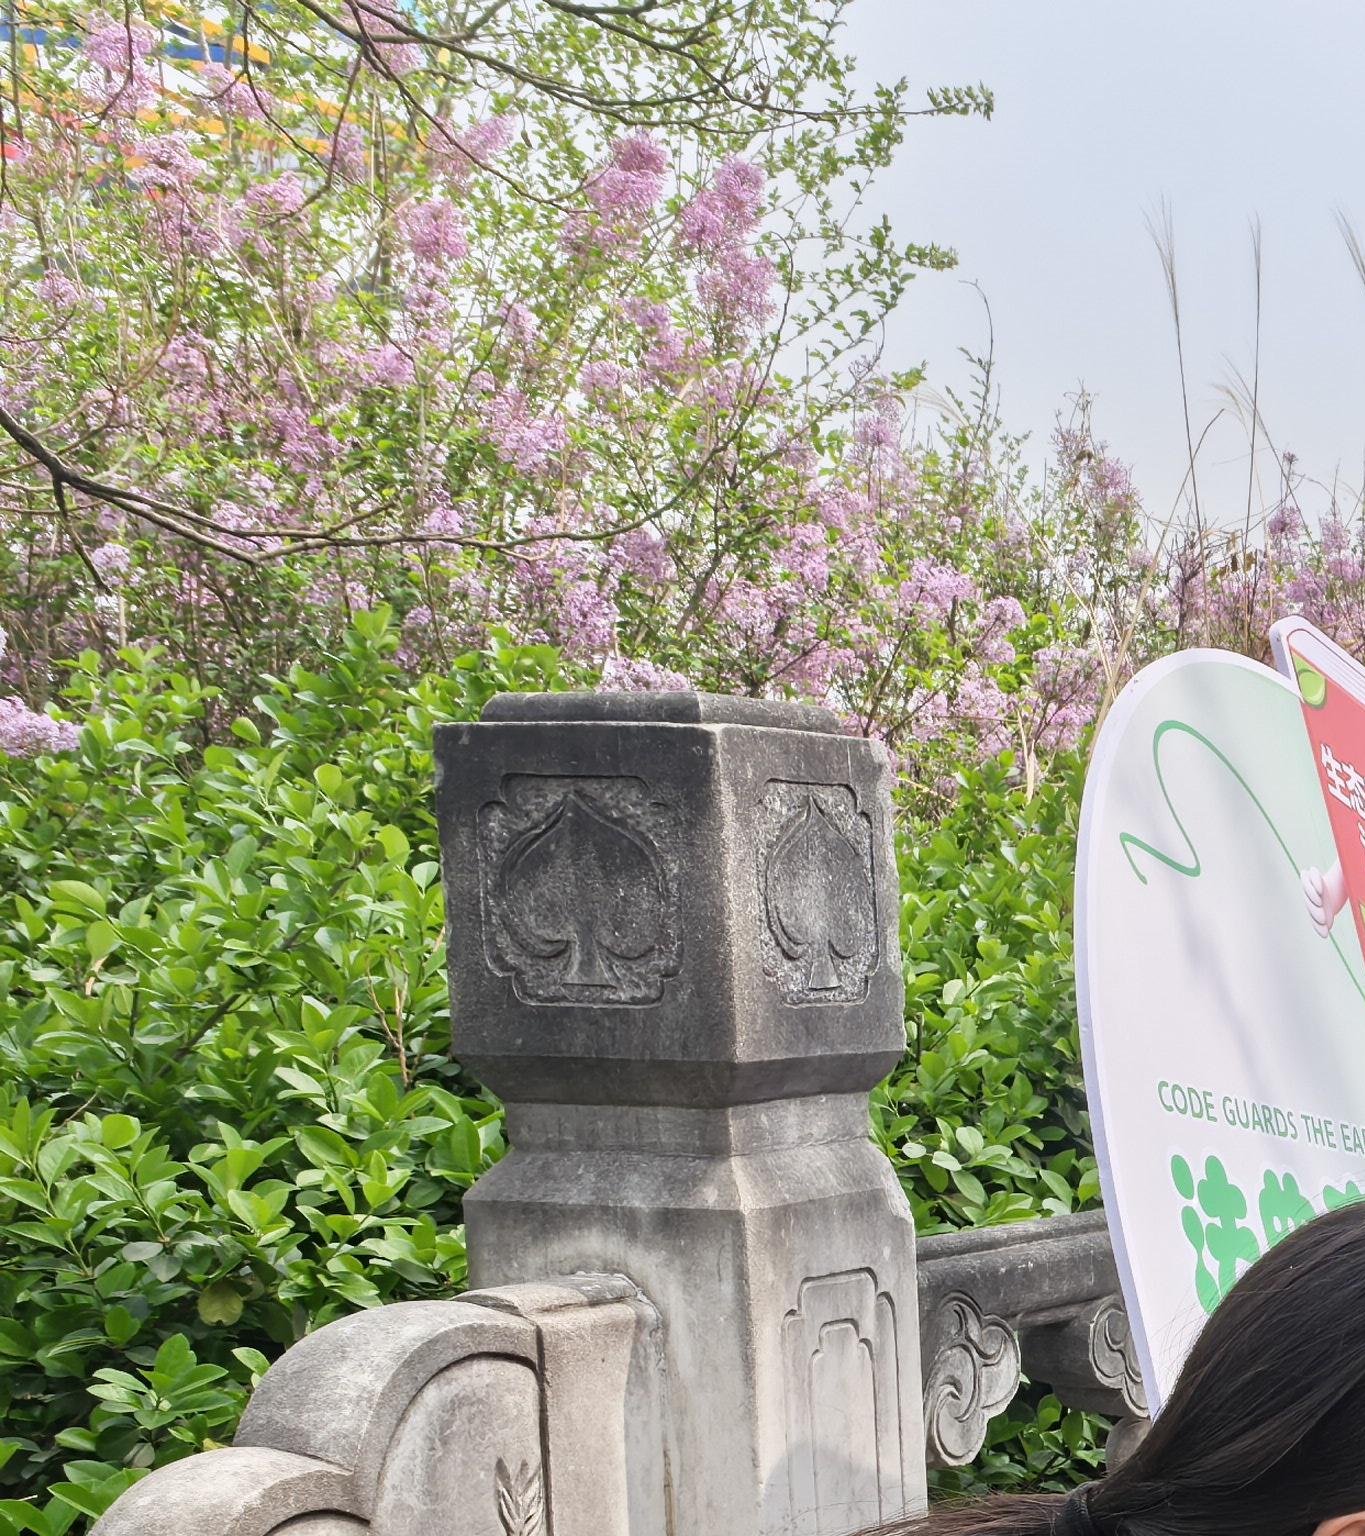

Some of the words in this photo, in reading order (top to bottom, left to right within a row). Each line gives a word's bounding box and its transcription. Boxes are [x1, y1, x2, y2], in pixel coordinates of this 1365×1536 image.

[1157, 1080, 1217, 1123] CODE
[1222, 1096, 1298, 1140] GUARDS
[1300, 1114, 1337, 1149] THE
